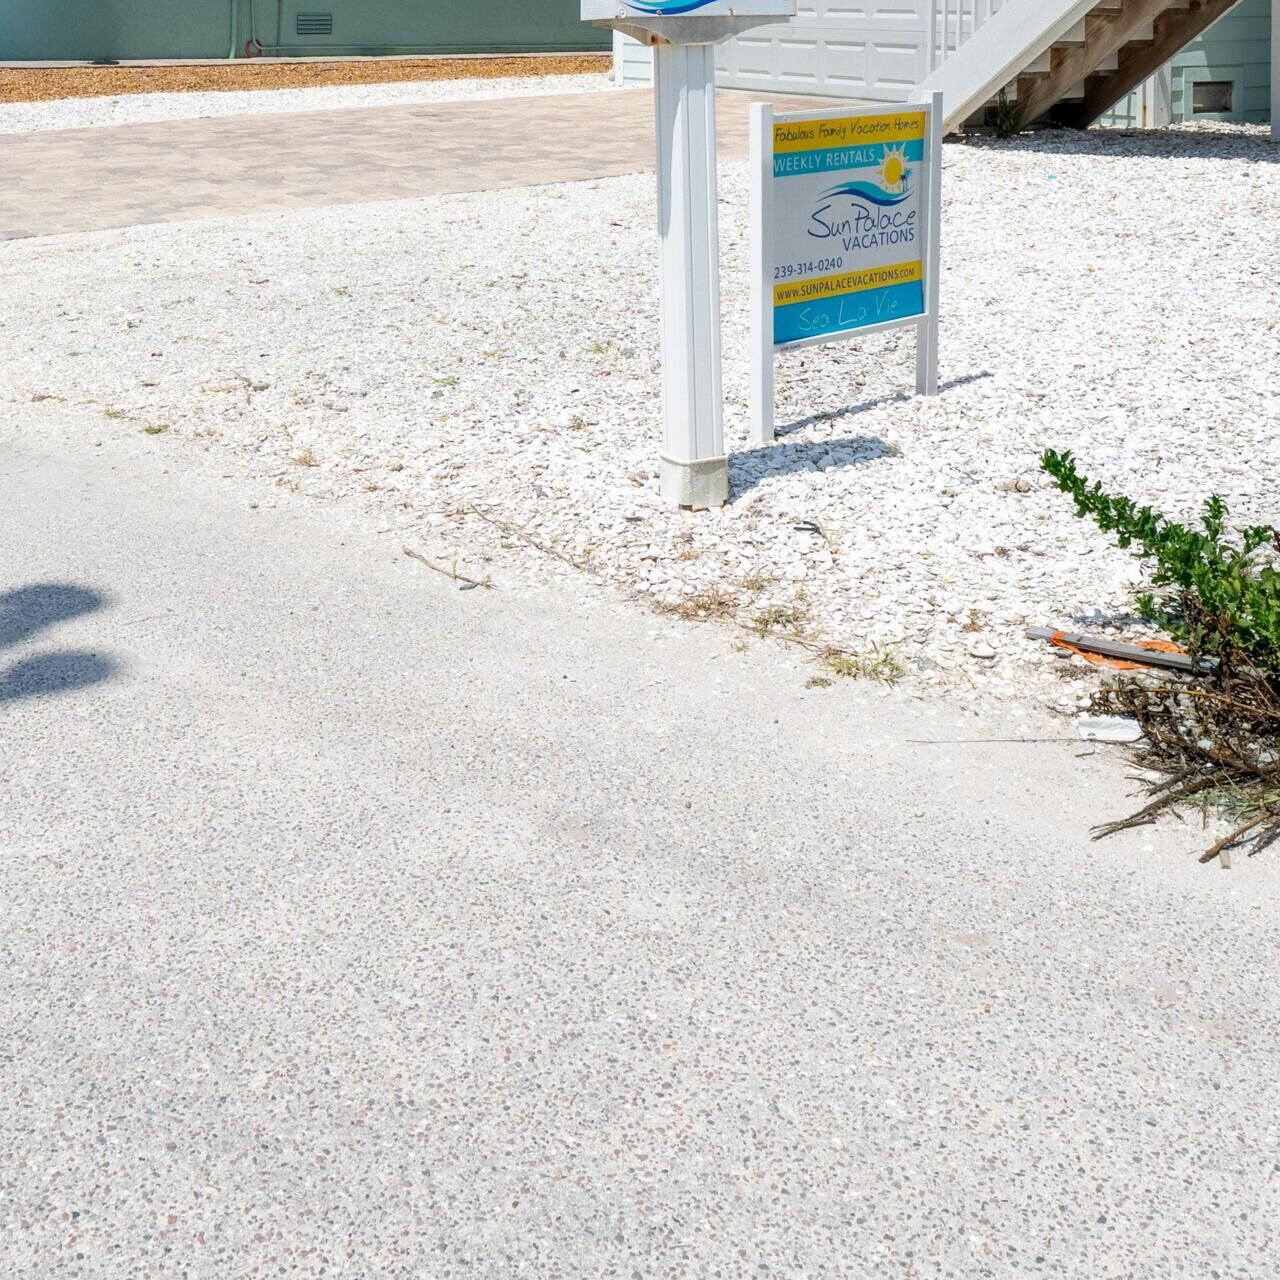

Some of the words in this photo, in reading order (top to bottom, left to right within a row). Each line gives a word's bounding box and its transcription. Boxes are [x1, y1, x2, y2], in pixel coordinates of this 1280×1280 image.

[775, 127, 815, 142] Fabulous
[818, 123, 846, 140] Family
[850, 120, 889, 135] Vacation
[894, 117, 919, 131] Homes
[773, 154, 822, 173] WEEKLY
[826, 148, 875, 166] RENTALS
[842, 227, 915, 251] VACATIONS
[774, 257, 843, 279] 239-314-0240
[798, 307, 830, 331] Sea
[838, 299, 867, 326] La
[875, 289, 899, 316] Vie
